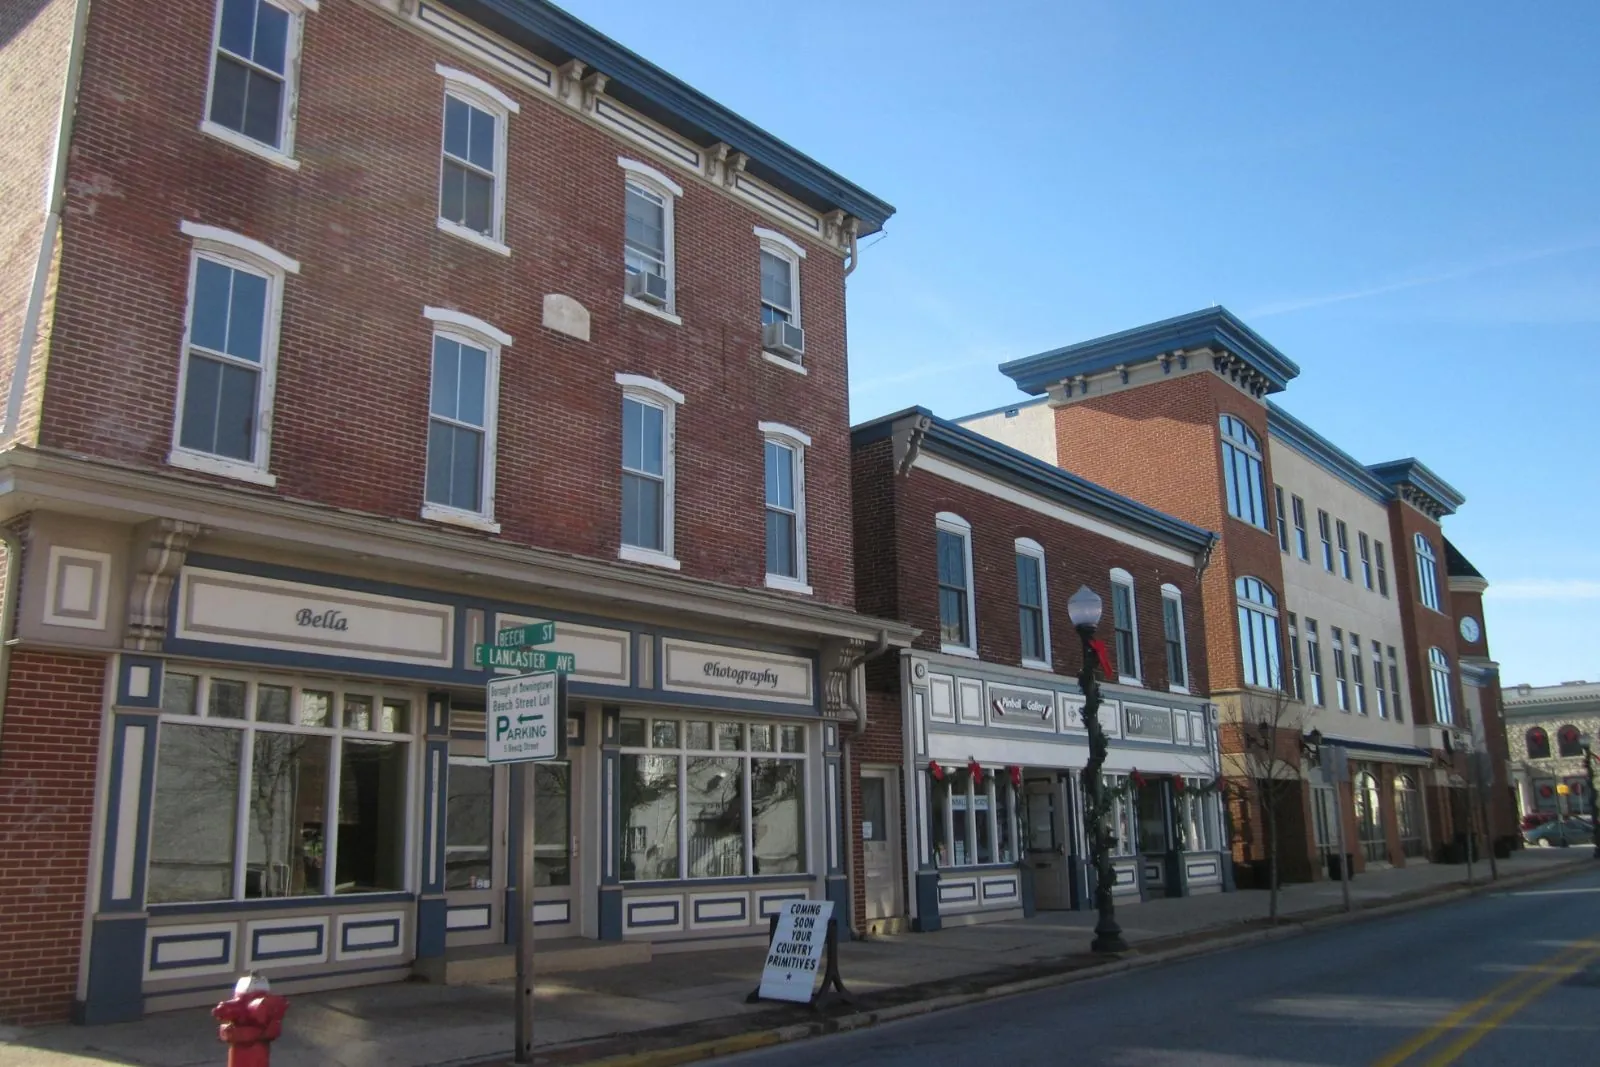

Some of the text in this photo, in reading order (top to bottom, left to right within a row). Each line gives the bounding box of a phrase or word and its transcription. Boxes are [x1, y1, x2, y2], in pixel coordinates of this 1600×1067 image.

[295, 608, 349, 631] Bella
[500, 624, 553, 647] BEECH ST
[476, 647, 573, 672] E LANCASTER AVE
[703, 661, 779, 689] Photography
[491, 685, 511, 697] Borough
[492, 694, 550, 712] Beech Street Lot
[496, 715, 547, 742] PARKING
[791, 904, 821, 914] COMING
[794, 918, 814, 928] SOON
[791, 931, 812, 941] YOUR
[776, 942, 813, 956] COUNTRY
[767, 955, 816, 970] PRIMITIVES
